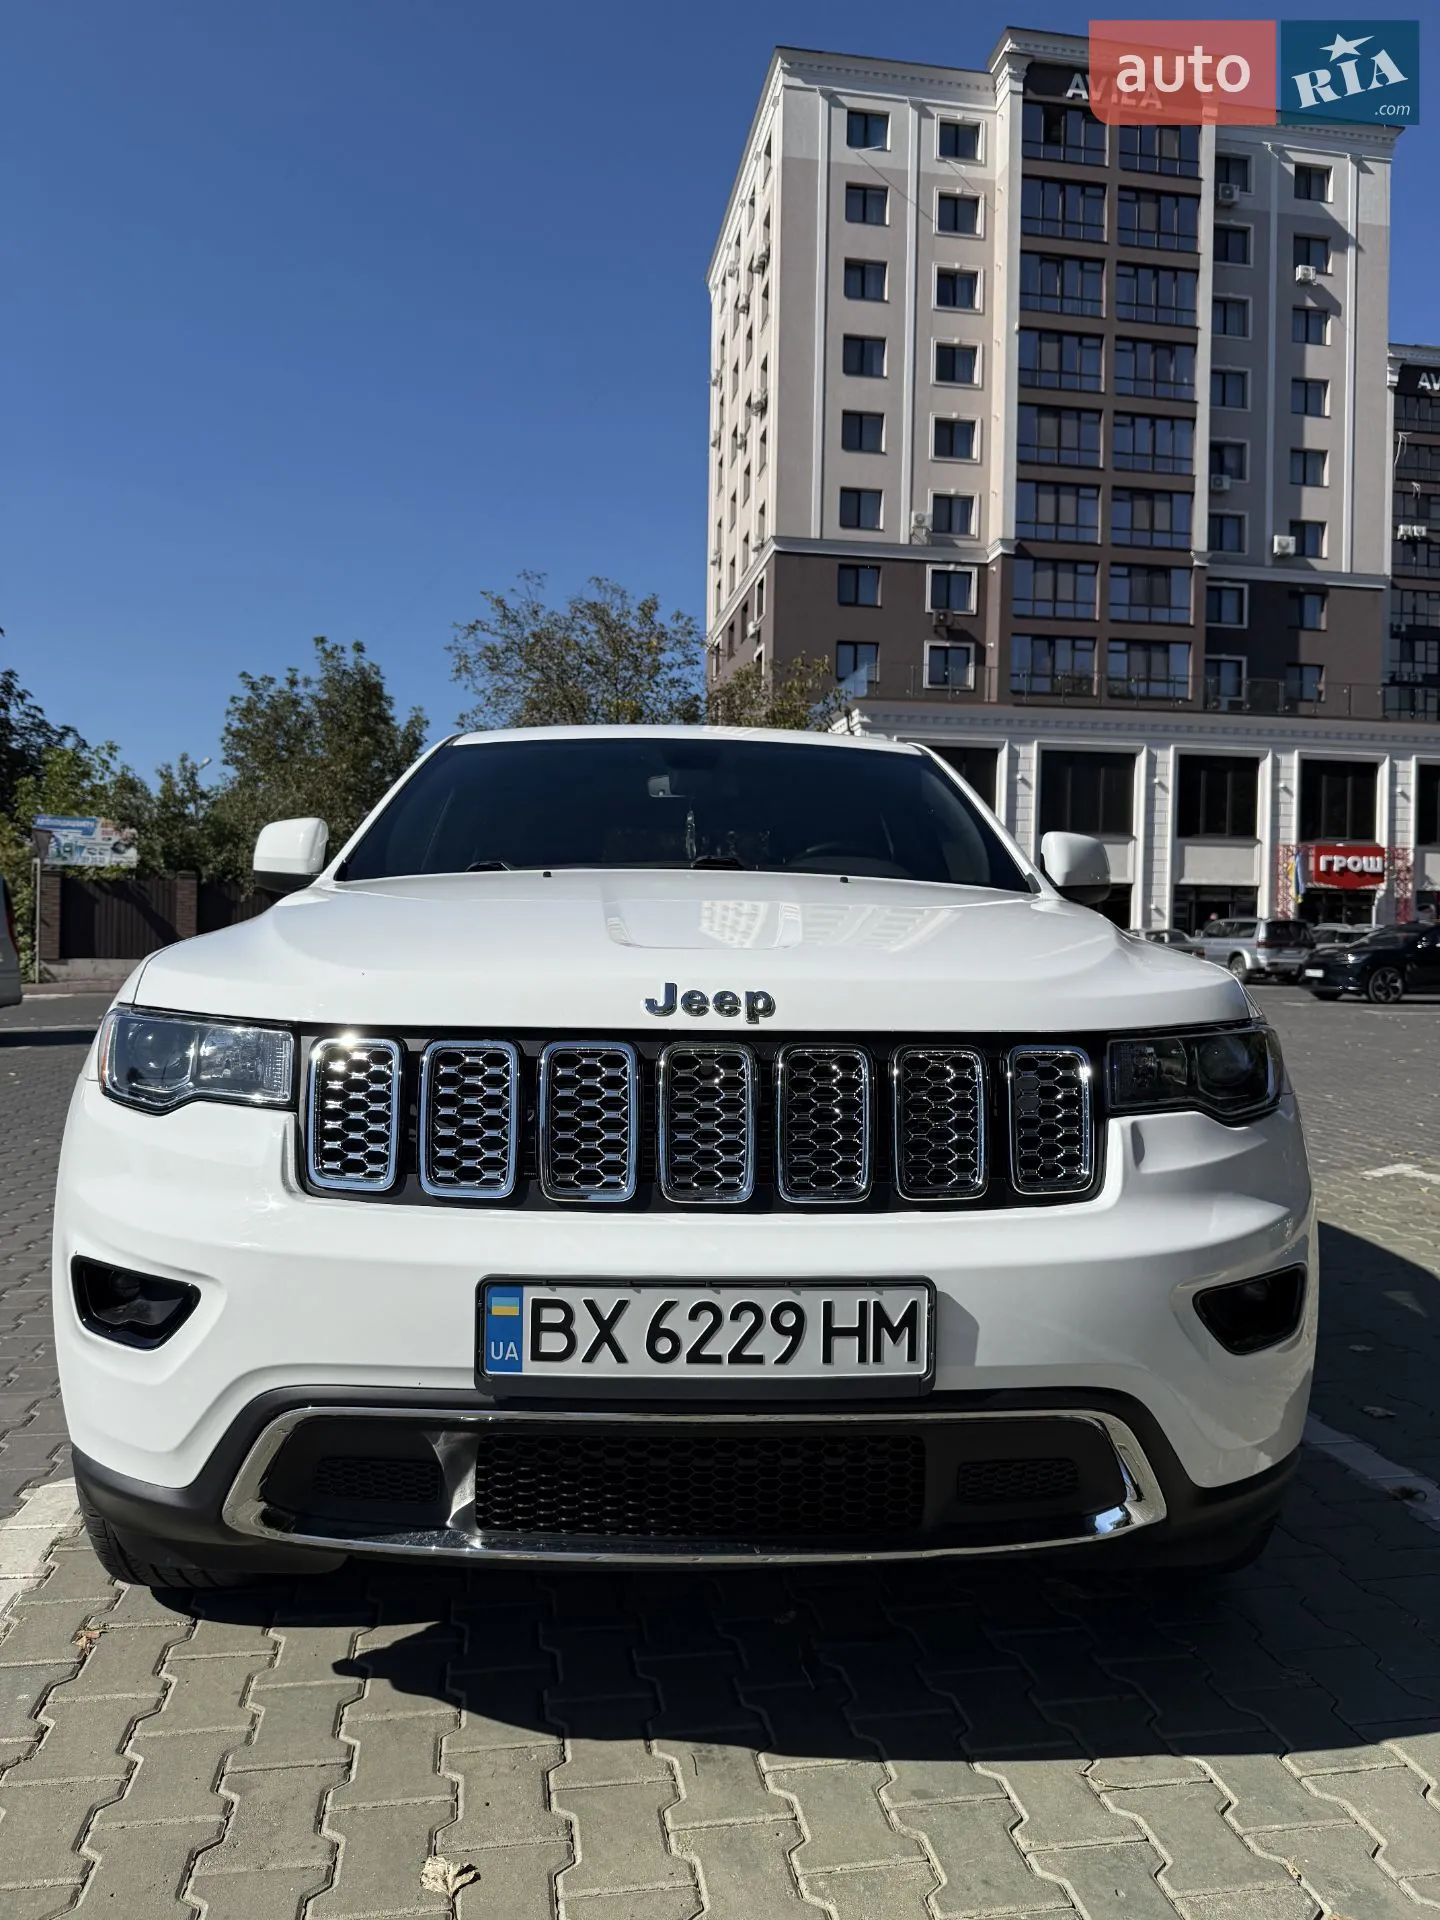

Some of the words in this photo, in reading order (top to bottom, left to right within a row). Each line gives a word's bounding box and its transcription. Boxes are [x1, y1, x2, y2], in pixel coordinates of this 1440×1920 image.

[1066, 73, 1162, 109] AVILA
[1319, 855, 1383, 873] ГРОШ
[645, 982, 776, 1024] Jeep
[529, 1297, 629, 1364] BX
[645, 1300, 806, 1365] 6229
[821, 1300, 918, 1364] HM
[490, 1341, 519, 1361] UA
